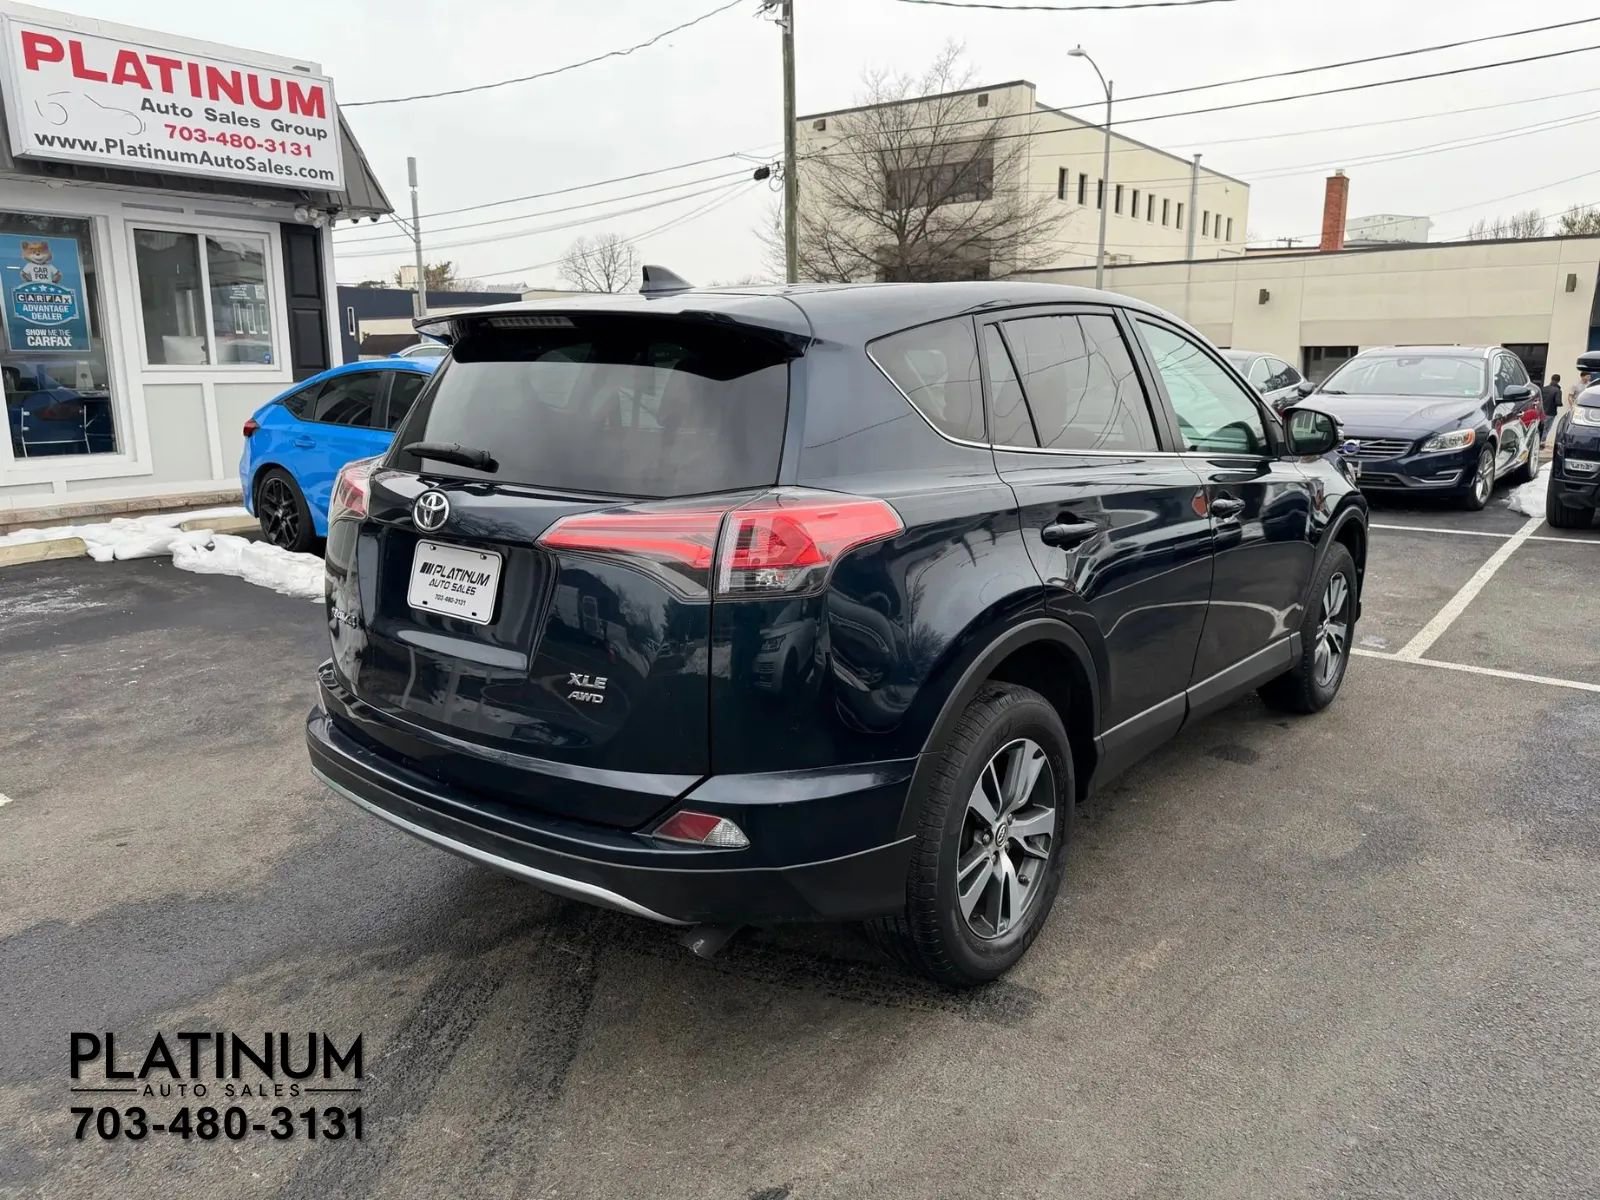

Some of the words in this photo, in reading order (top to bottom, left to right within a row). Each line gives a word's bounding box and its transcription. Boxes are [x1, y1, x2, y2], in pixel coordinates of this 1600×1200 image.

[21, 30, 326, 119] PLATINUM
[140, 97, 193, 118] Auto
[204, 107, 260, 129] Sales
[270, 118, 328, 141] Group
[164, 124, 312, 158] 703-480-3131
[34, 132, 334, 181] www.PlatinumAutoSales.com
[18, 294, 72, 304] CARFAX
[23, 304, 69, 313] ADVANTAGE
[32, 312, 62, 320] DEALER
[27, 336, 72, 347] CARFAX
[433, 564, 491, 586] PLATINUM
[429, 578, 451, 590] AUTO
[451, 582, 476, 595] SALES
[567, 672, 608, 690] XLE
[567, 690, 604, 703] AWD
